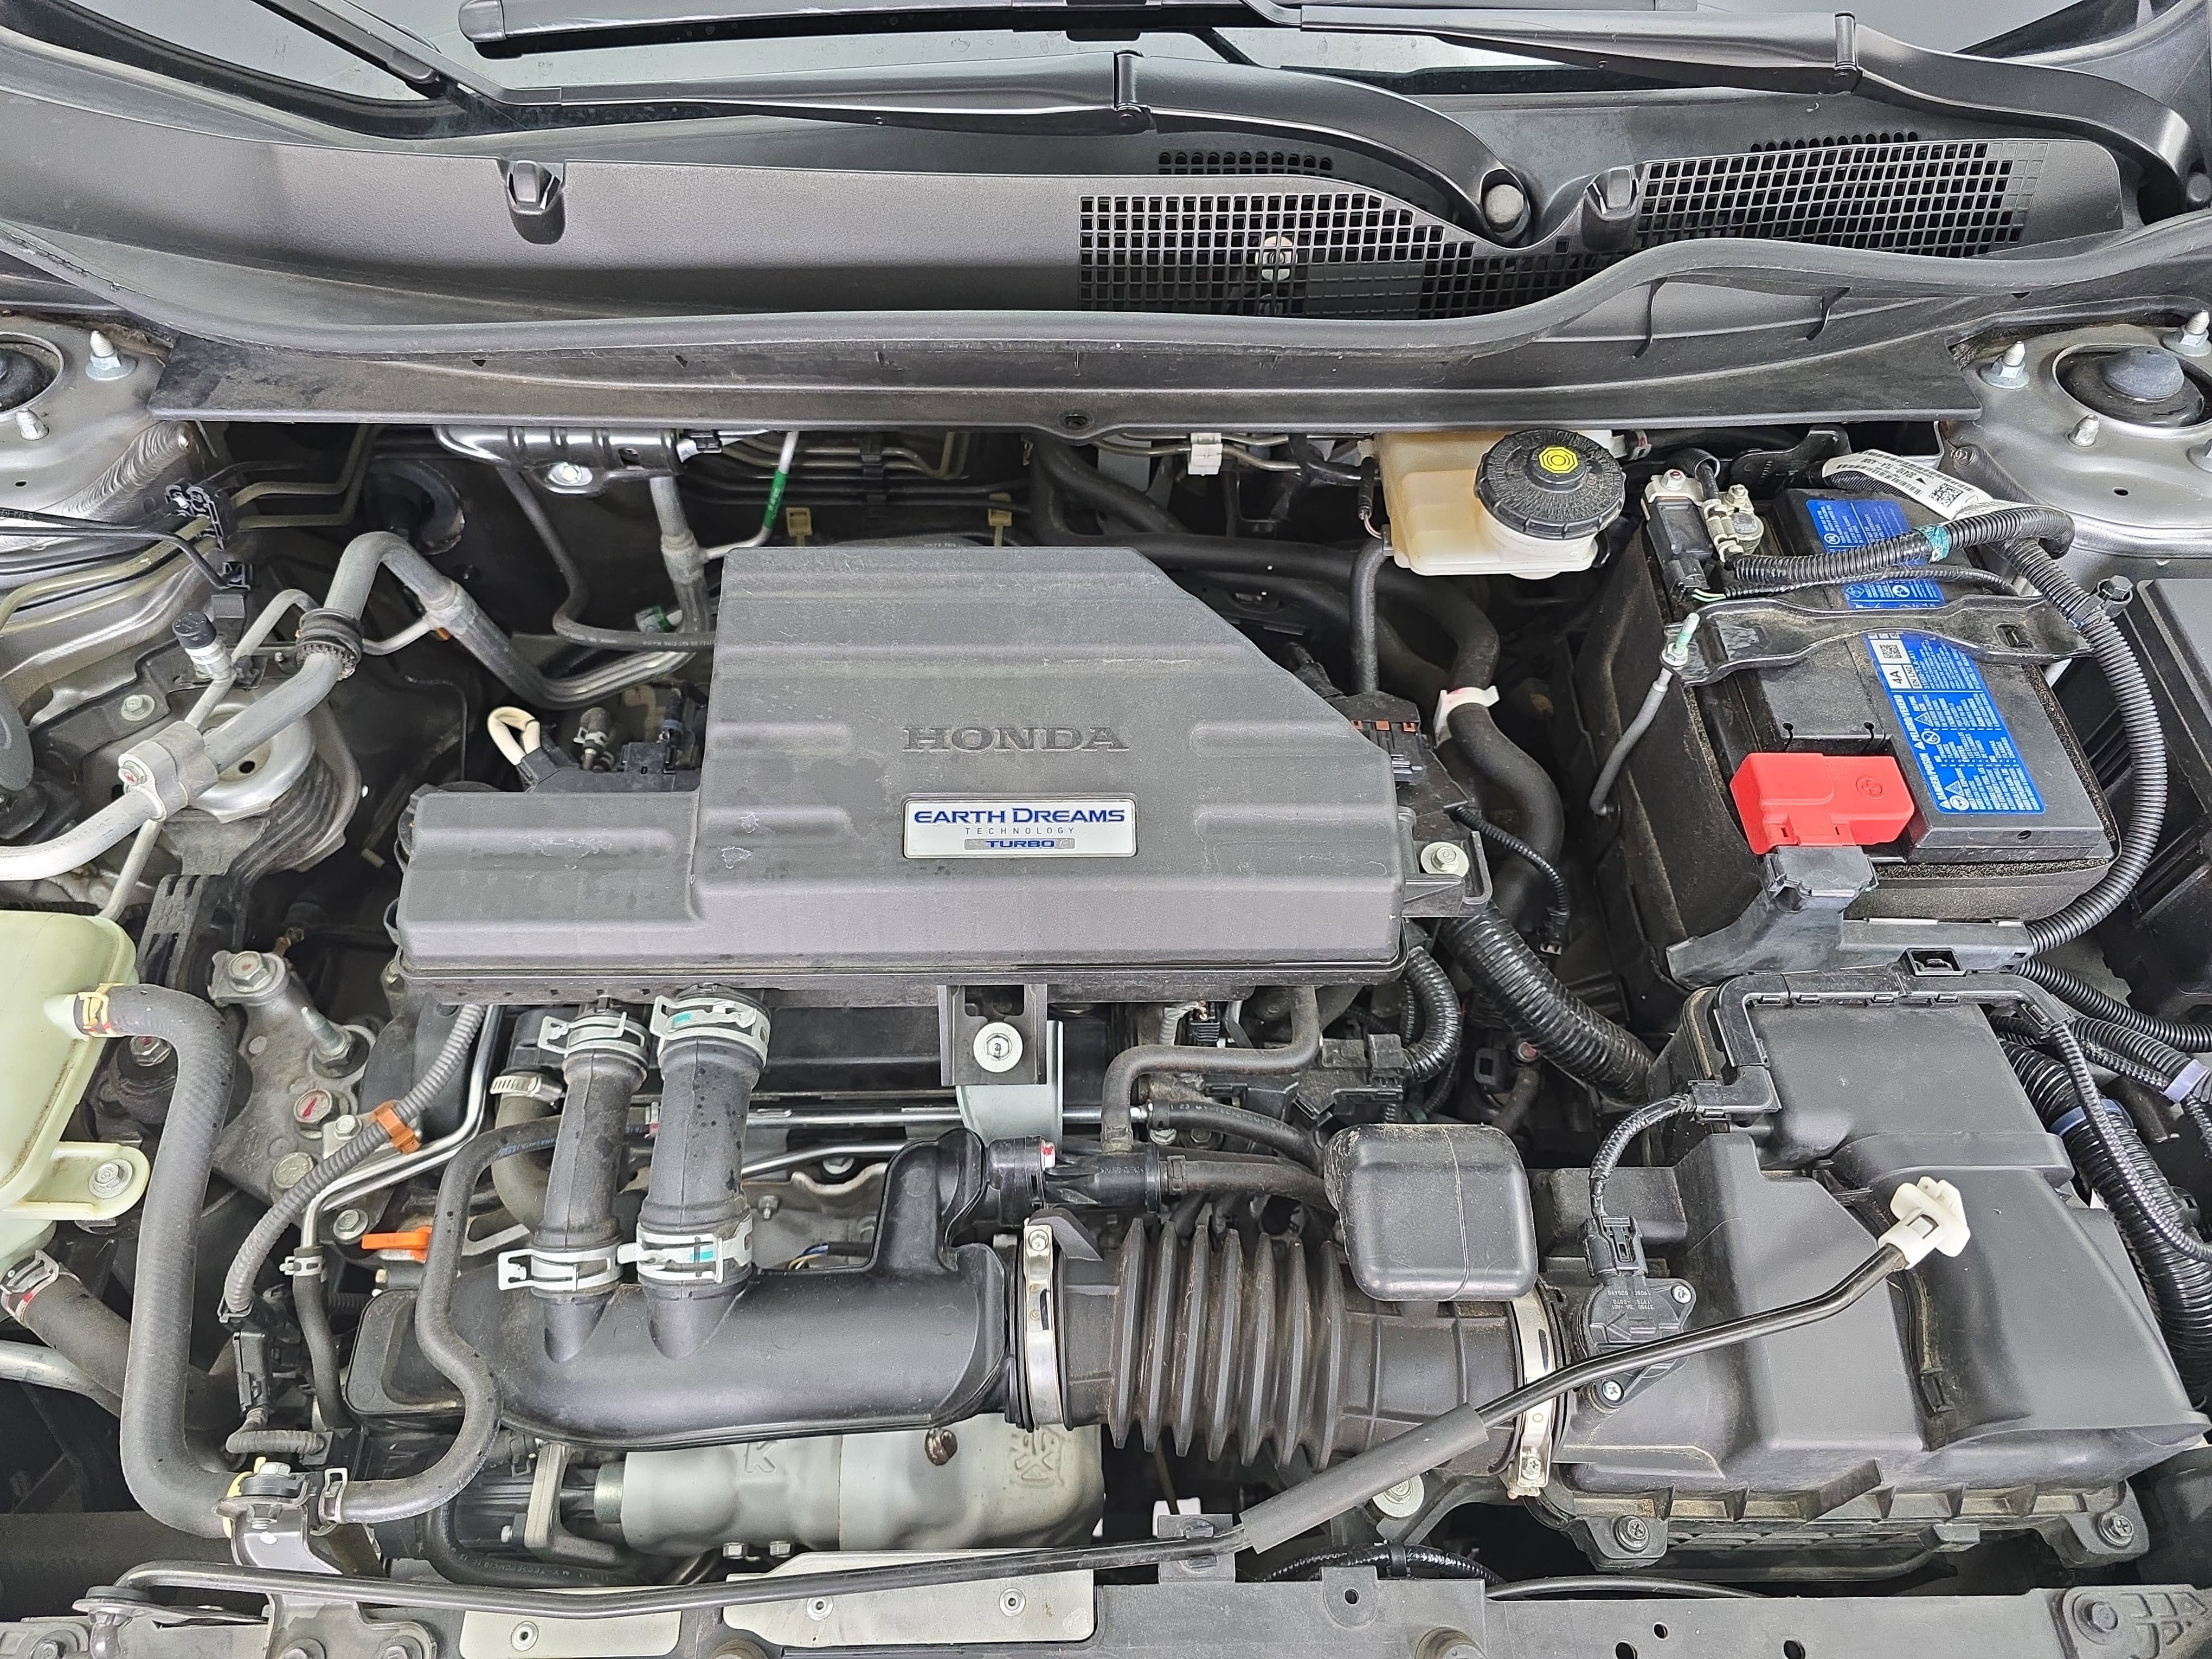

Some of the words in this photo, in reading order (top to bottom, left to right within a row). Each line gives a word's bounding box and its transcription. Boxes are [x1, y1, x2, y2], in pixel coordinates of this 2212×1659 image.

[1889, 671, 1903, 684] 4A
[1905, 666, 1915, 677] LN2
[1907, 650, 1930, 689] 31500-TLA-A11
[1893, 695, 1921, 741] PELIGRO/VENENO
[902, 726, 1129, 753] HONDA
[1918, 753, 1947, 800] DANGER/POISON
[914, 810, 1006, 823] EARTH
[1013, 808, 1126, 823] DREAMS
[986, 840, 1054, 848] TURBO
